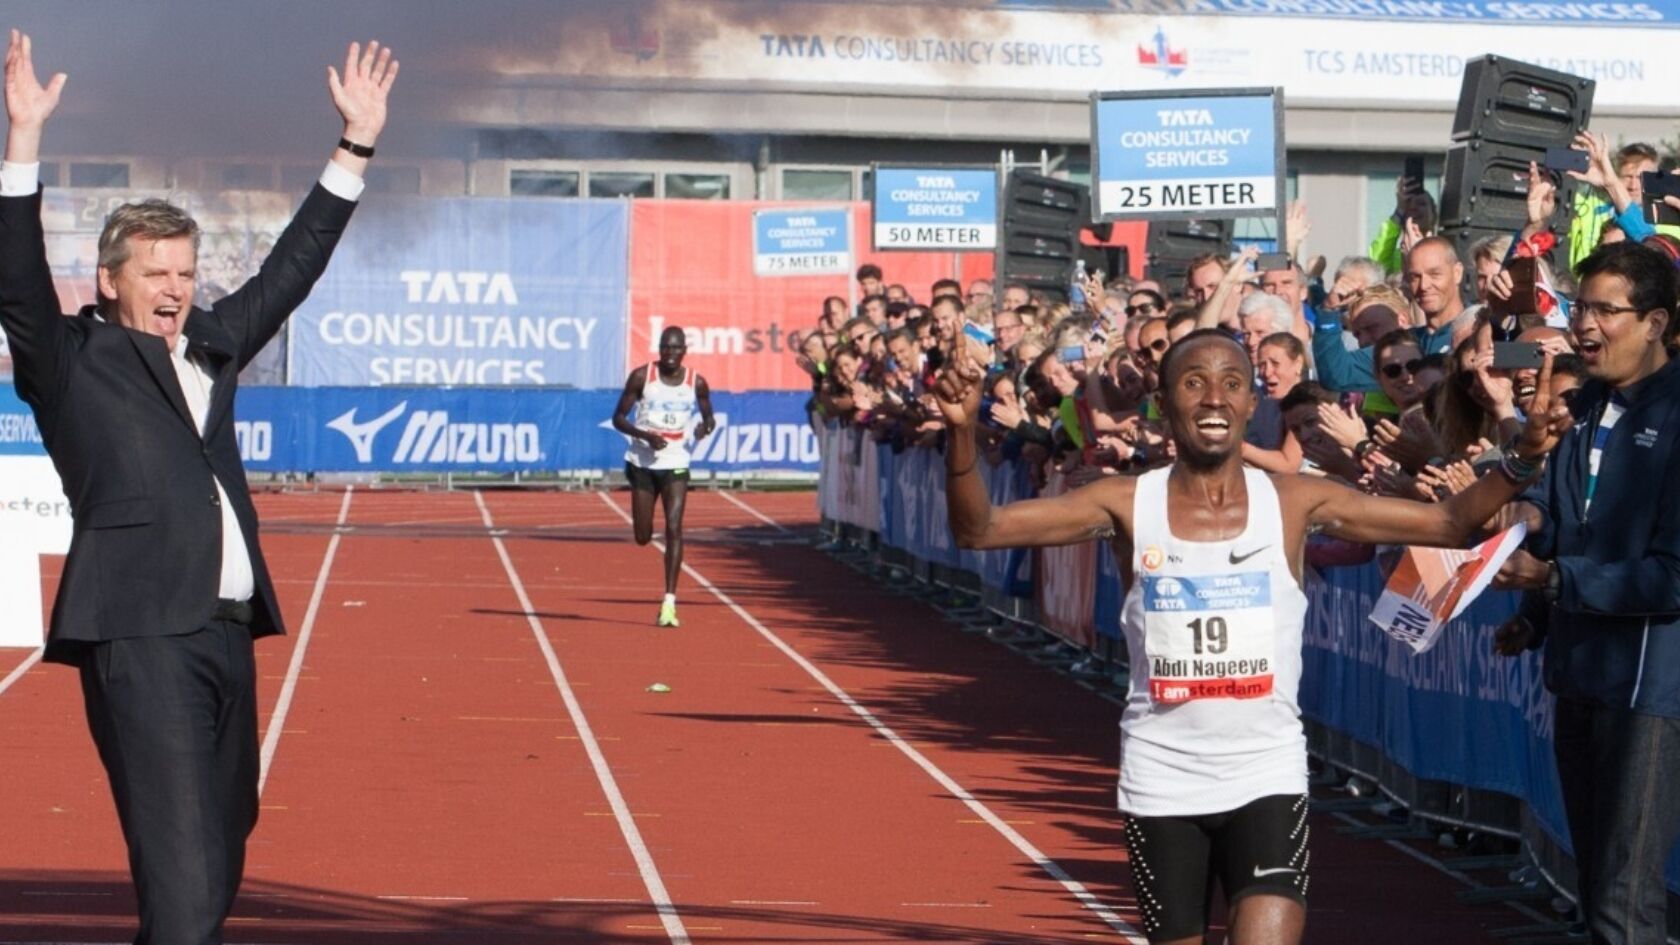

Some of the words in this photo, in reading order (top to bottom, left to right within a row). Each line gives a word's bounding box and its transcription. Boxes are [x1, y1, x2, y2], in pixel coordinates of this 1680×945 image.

[760, 35, 826, 58] TATA
[833, 35, 995, 65] CONSULTANCY
[1000, 41, 1104, 67] SERVICES
[1304, 50, 1346, 73] TCS
[1353, 52, 1461, 78] AMSTERD
[1157, 109, 1214, 126] TATA
[1120, 129, 1252, 148] CONSULTANCY
[1145, 150, 1229, 168] SERVICES
[916, 176, 955, 189] TATA
[890, 190, 981, 203] CONSULTANCY
[1120, 187, 1152, 208] 25
[1162, 183, 1255, 206] METER
[907, 203, 965, 217] SERVICES
[786, 217, 817, 227] TATA
[767, 227, 837, 238] CONSULTANCY
[889, 228, 911, 242] 50
[917, 227, 981, 243] METER
[780, 238, 825, 249] SERVICES
[768, 257, 786, 269] 75
[789, 254, 838, 268] METER
[400, 270, 518, 305] TATA
[318, 311, 598, 350] CONSULTANCY
[369, 357, 546, 386] SERVICES
[662, 413, 677, 425] 45
[1213, 577, 1242, 587] TATA
[1153, 599, 1186, 610] TATA
[1186, 616, 1229, 655] 19
[1154, 658, 1188, 677] Abdi
[1193, 657, 1269, 678] Nageeye
